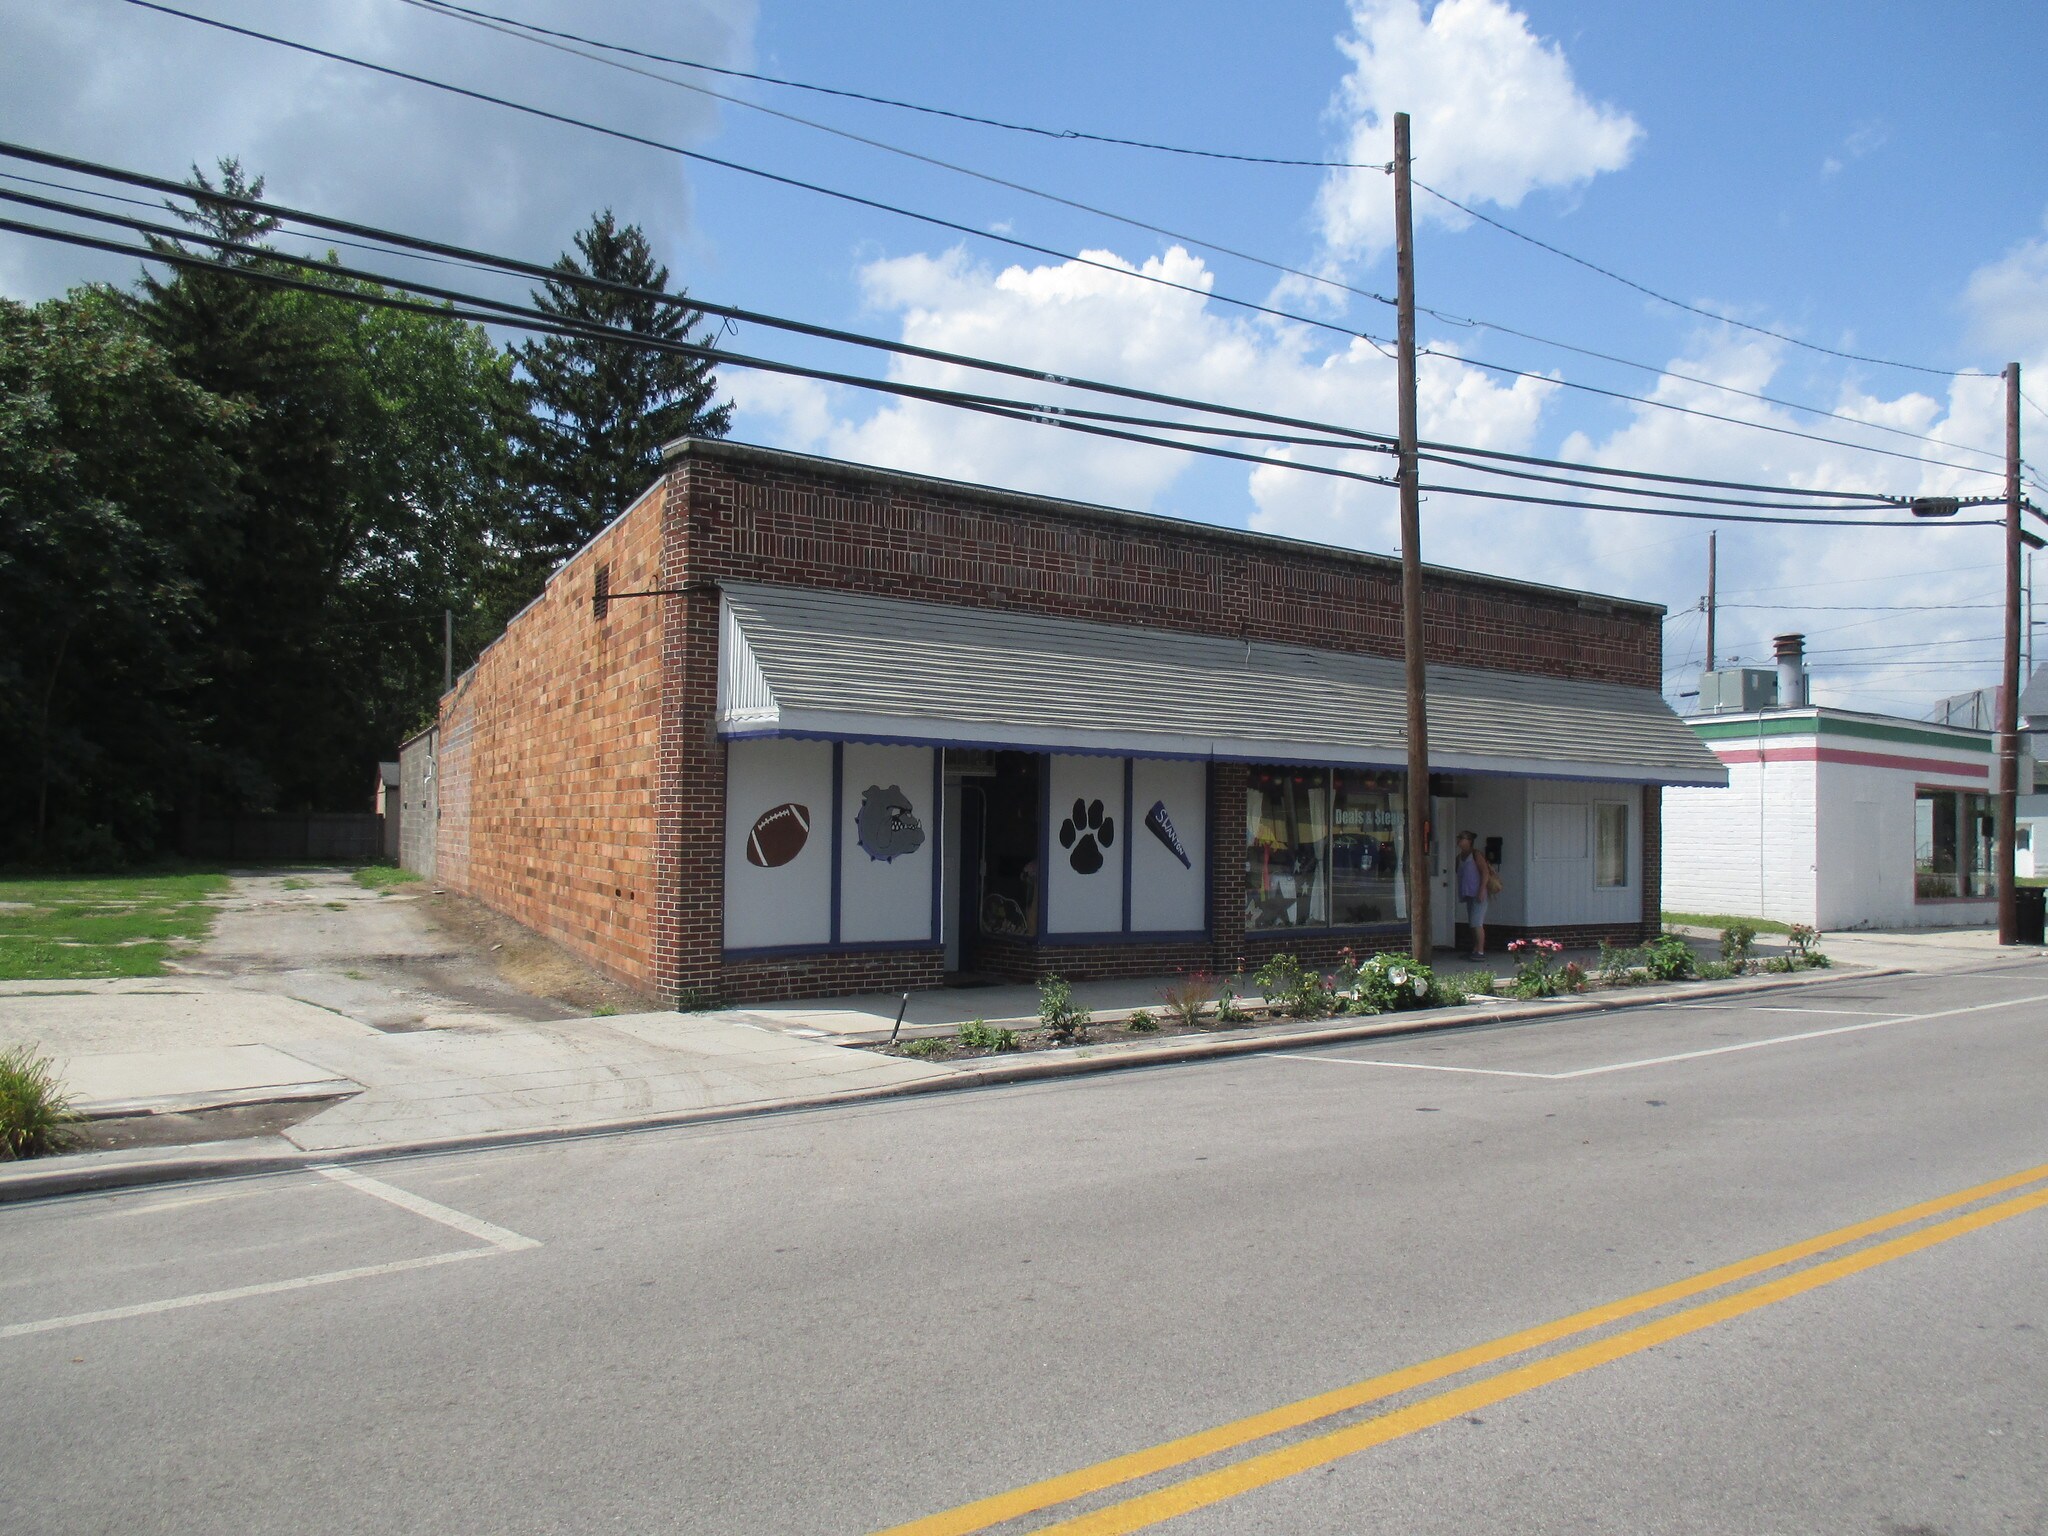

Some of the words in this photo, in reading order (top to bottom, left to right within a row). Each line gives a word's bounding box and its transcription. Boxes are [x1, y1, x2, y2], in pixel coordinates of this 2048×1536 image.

[1155, 808, 1185, 856] SWANTON
[1335, 808, 1364, 825] Deals
[1365, 810, 1373, 825] &
